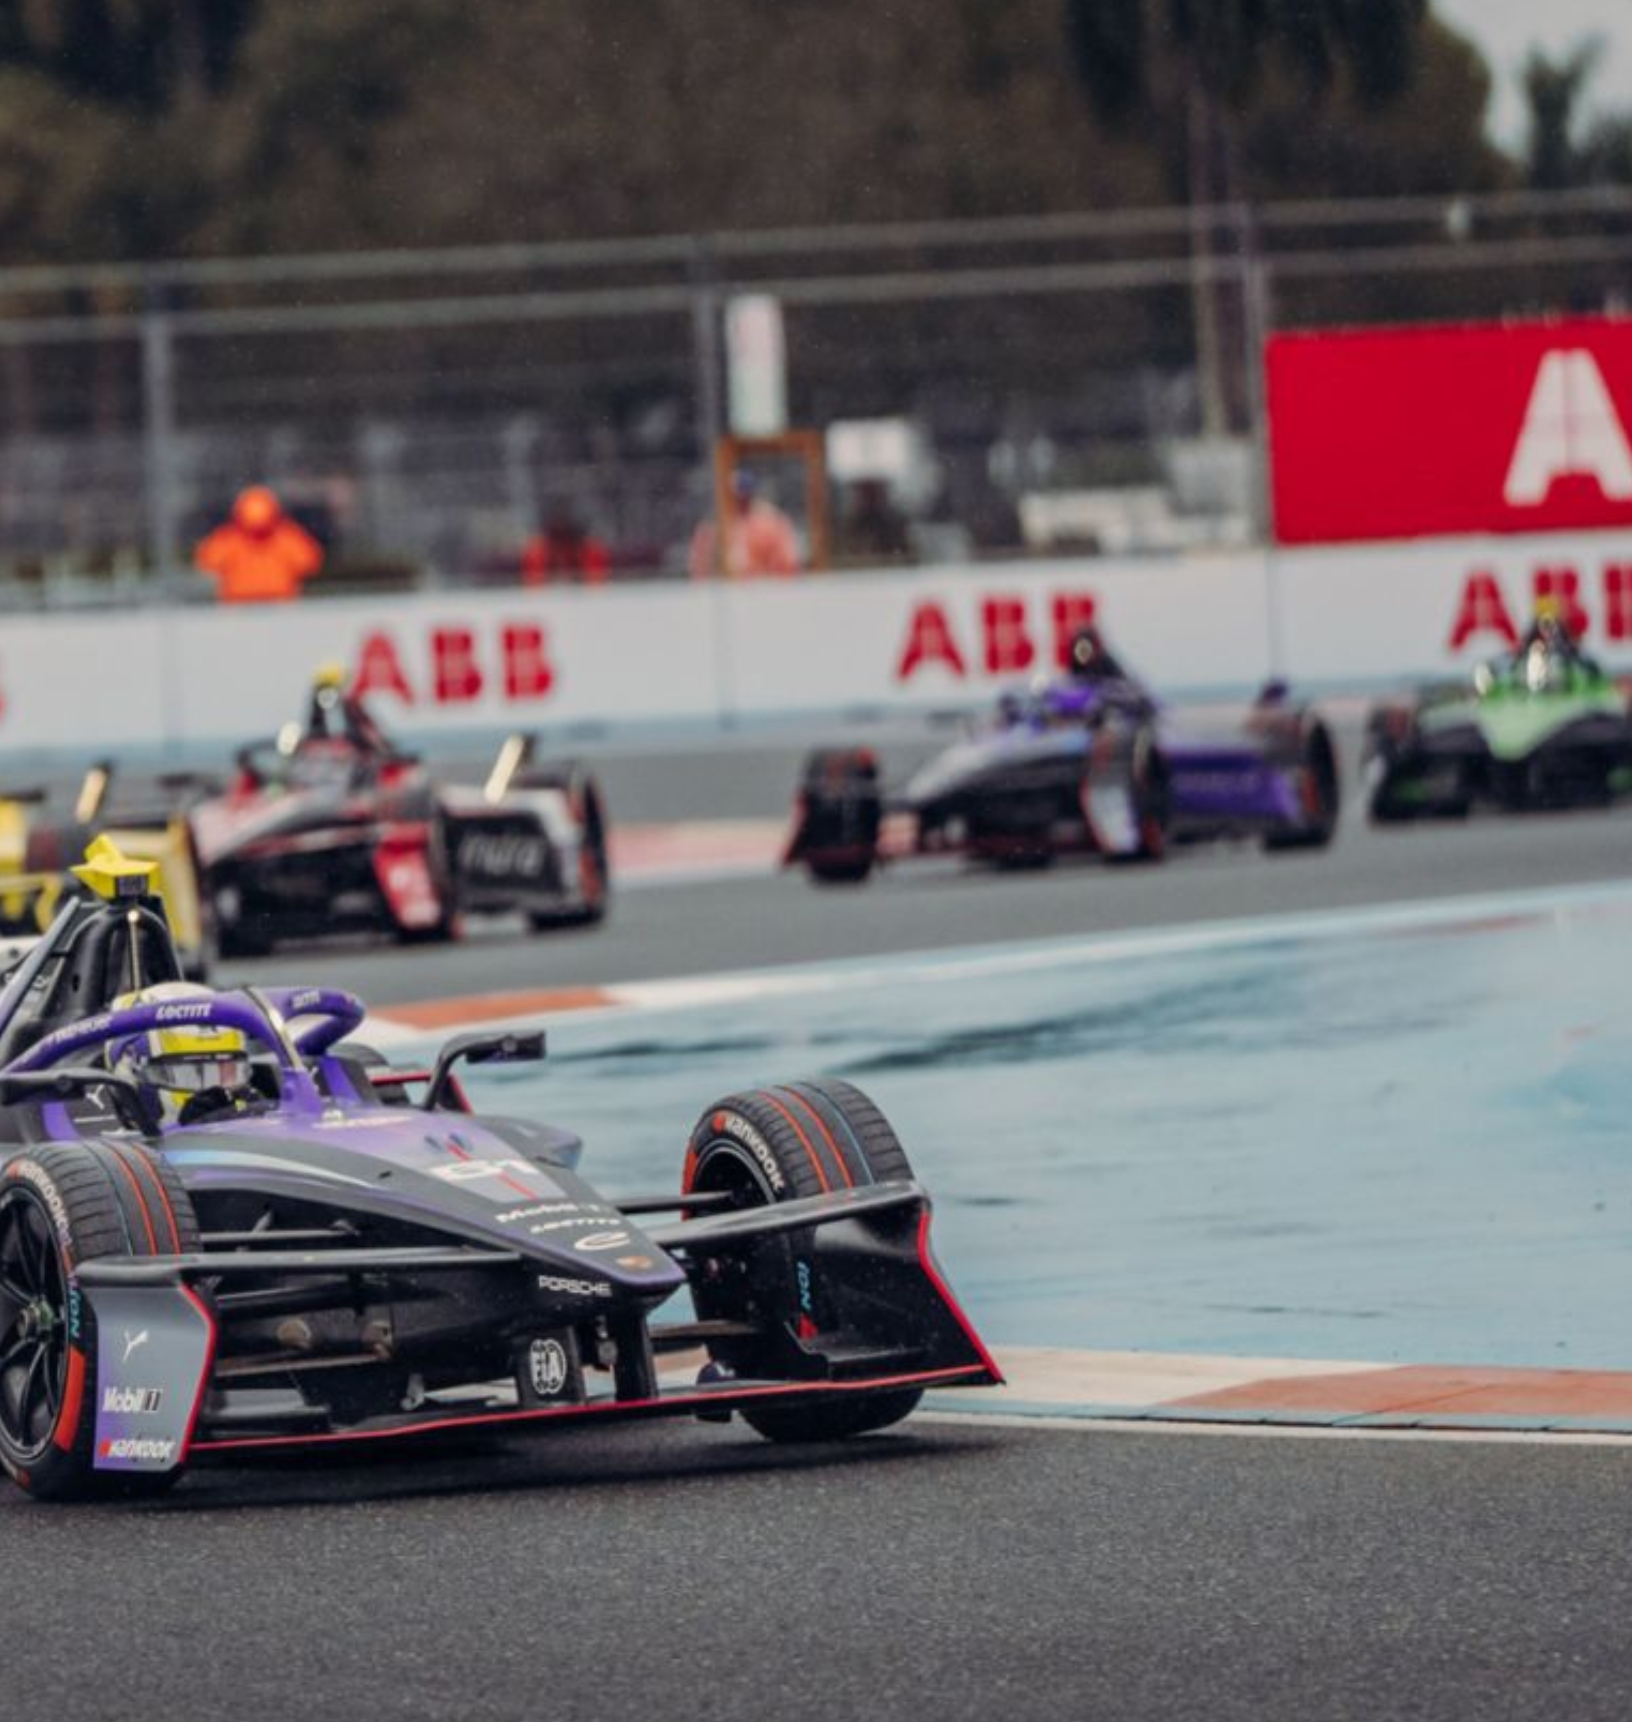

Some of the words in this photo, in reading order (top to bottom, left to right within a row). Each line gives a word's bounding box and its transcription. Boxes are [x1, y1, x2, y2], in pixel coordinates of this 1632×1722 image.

[347, 624, 555, 705] ABB
[537, 1275, 613, 1298] PORSCHE
[531, 1351, 562, 1382] FIA
